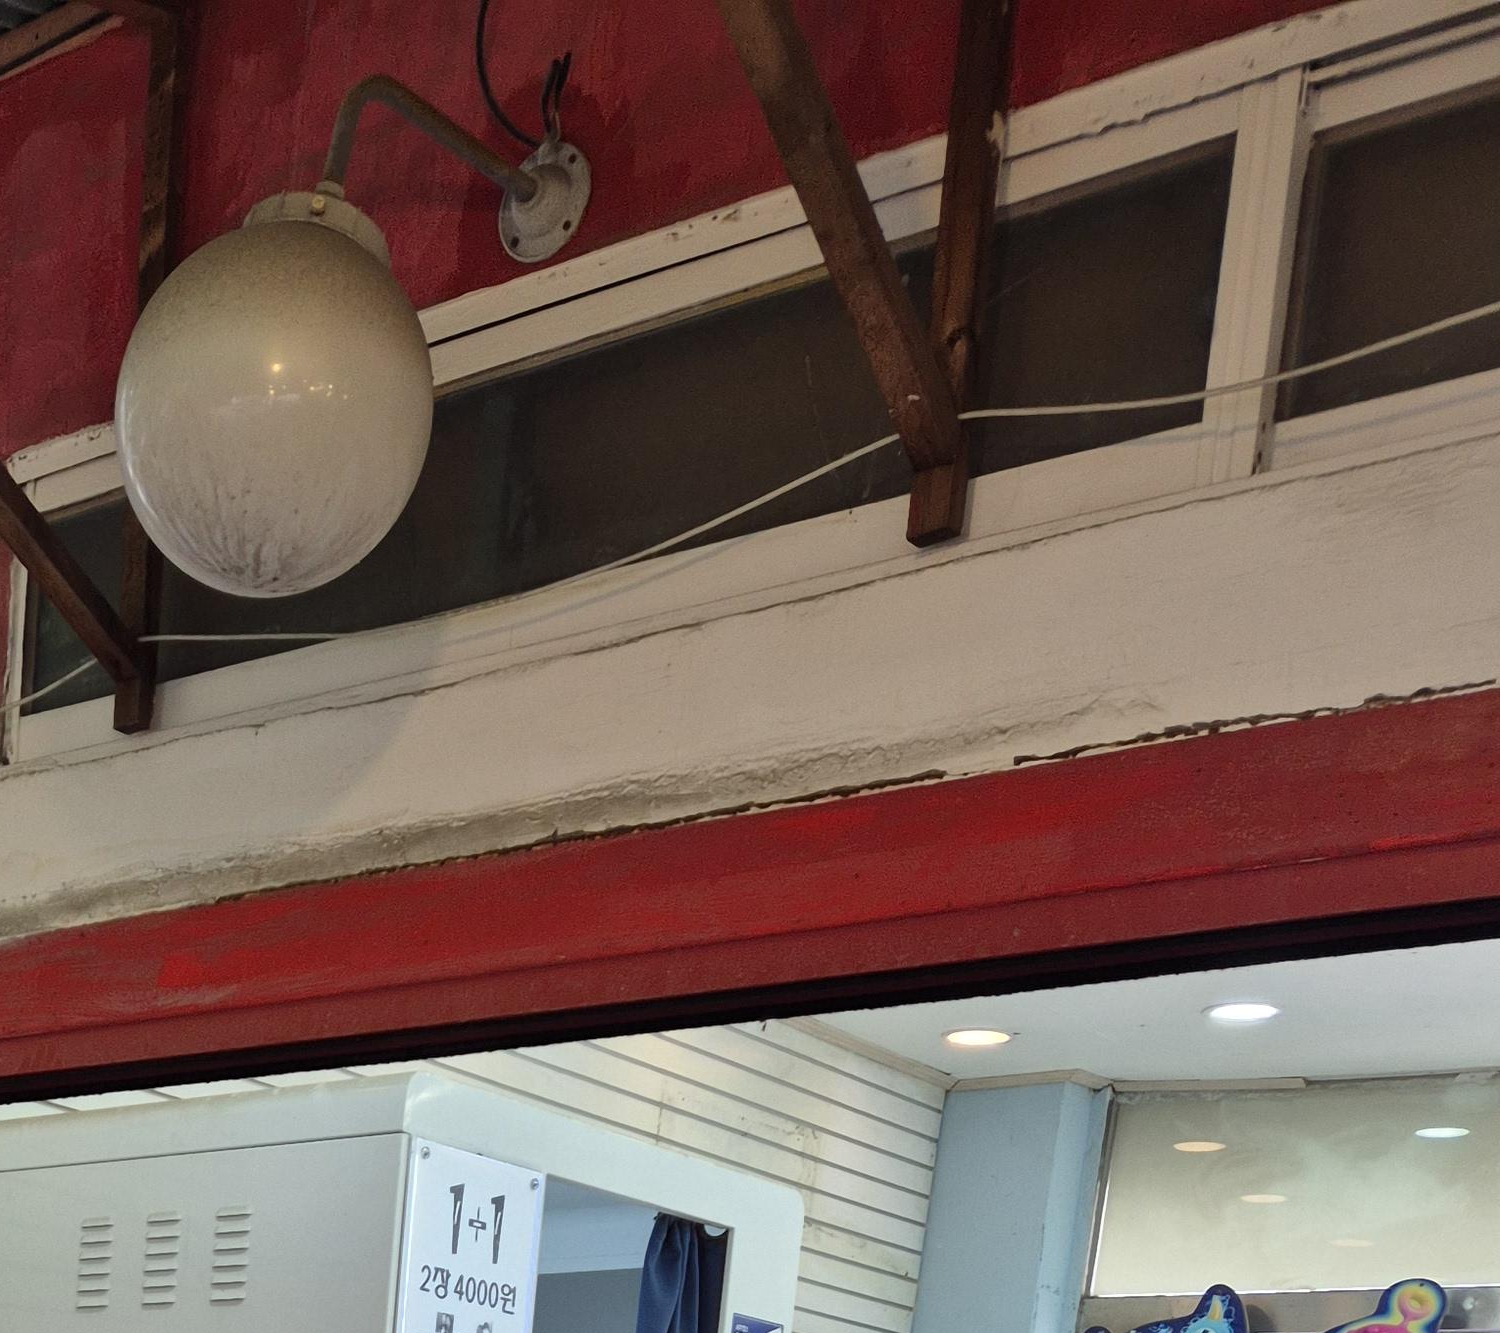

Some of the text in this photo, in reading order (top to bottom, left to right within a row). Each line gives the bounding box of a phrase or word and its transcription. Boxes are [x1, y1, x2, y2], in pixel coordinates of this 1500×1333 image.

[450, 1184, 505, 1265] 1+1
[419, 1264, 517, 1316] 2장 4000원
